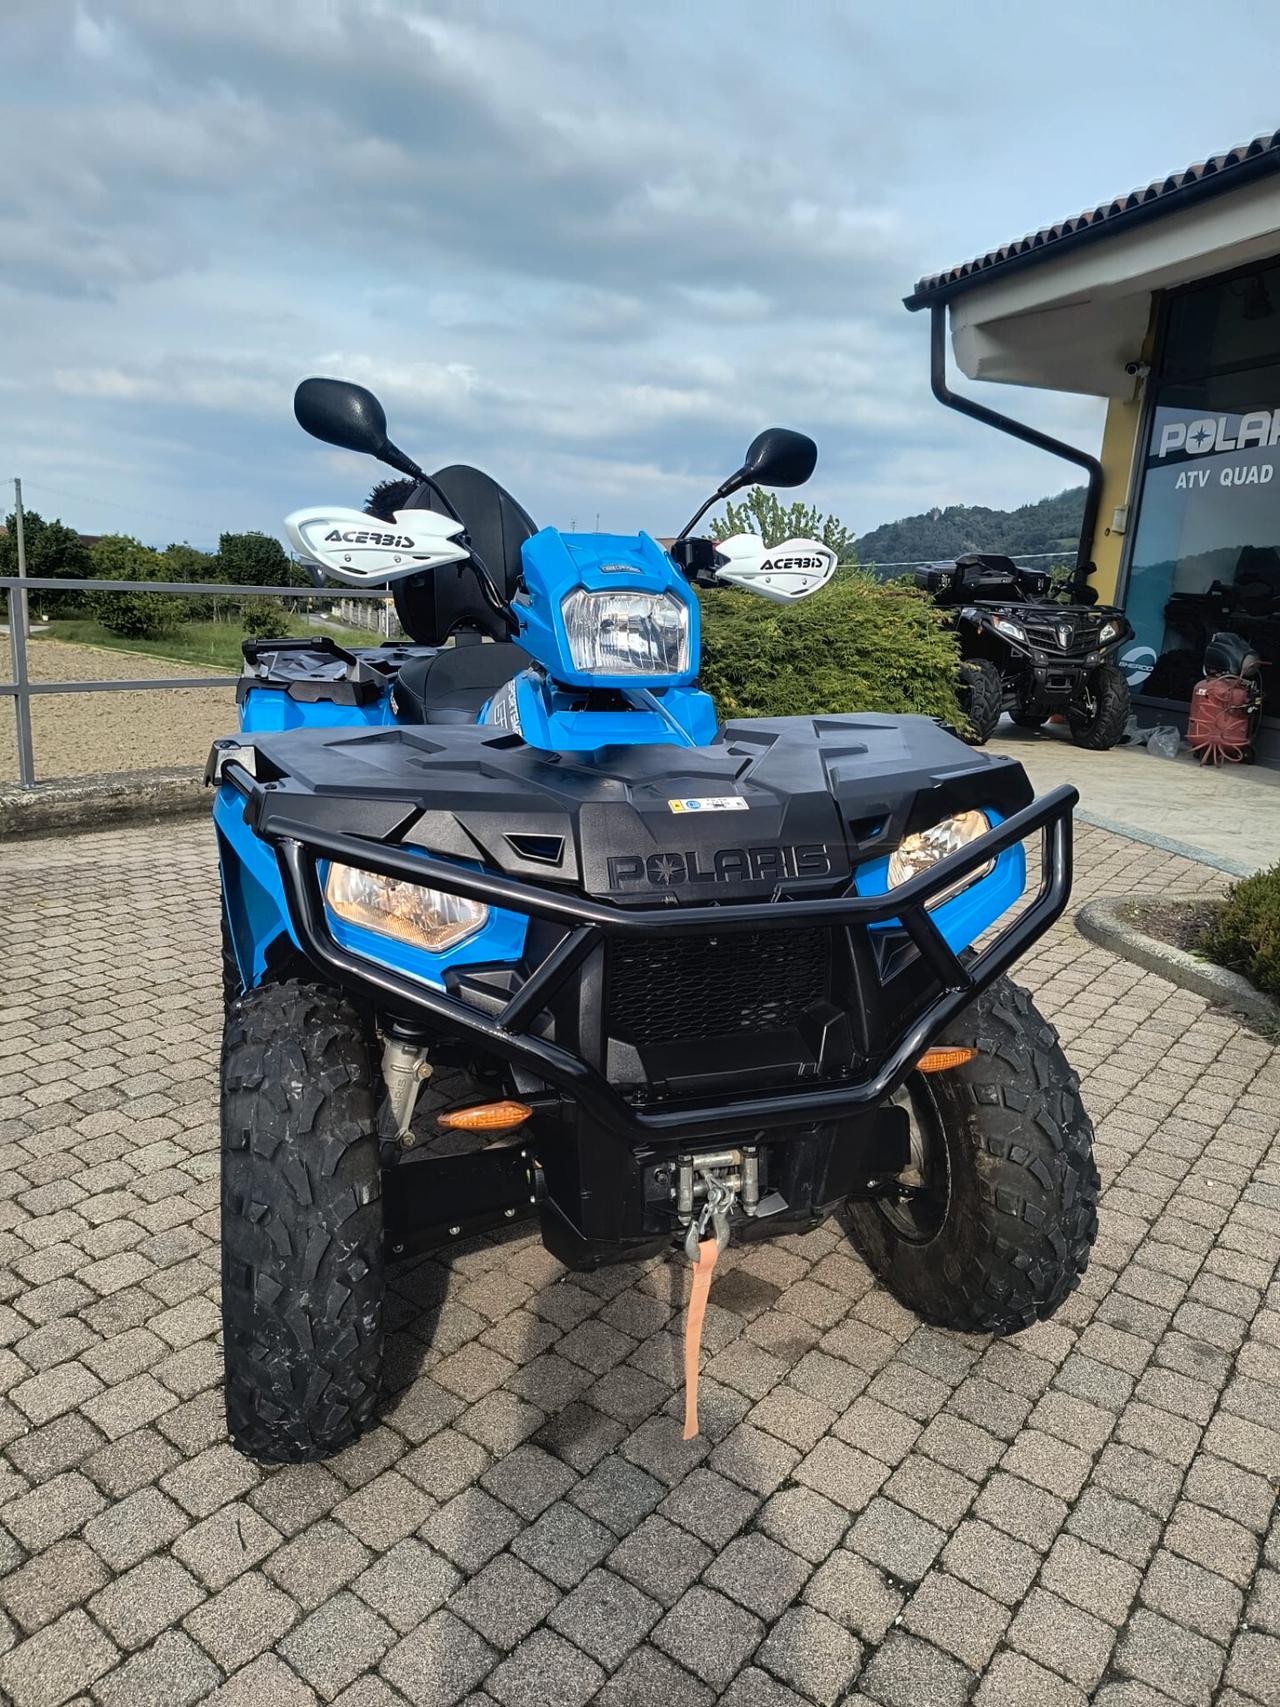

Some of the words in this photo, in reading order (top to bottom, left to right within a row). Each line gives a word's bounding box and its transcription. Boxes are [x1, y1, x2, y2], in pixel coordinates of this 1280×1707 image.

[1175, 469, 1210, 489] ATV
[1220, 464, 1274, 487] QUAD
[324, 529, 415, 549] ACERBIS
[760, 557, 823, 571] ACERBIS
[606, 843, 831, 890] POLARIS
